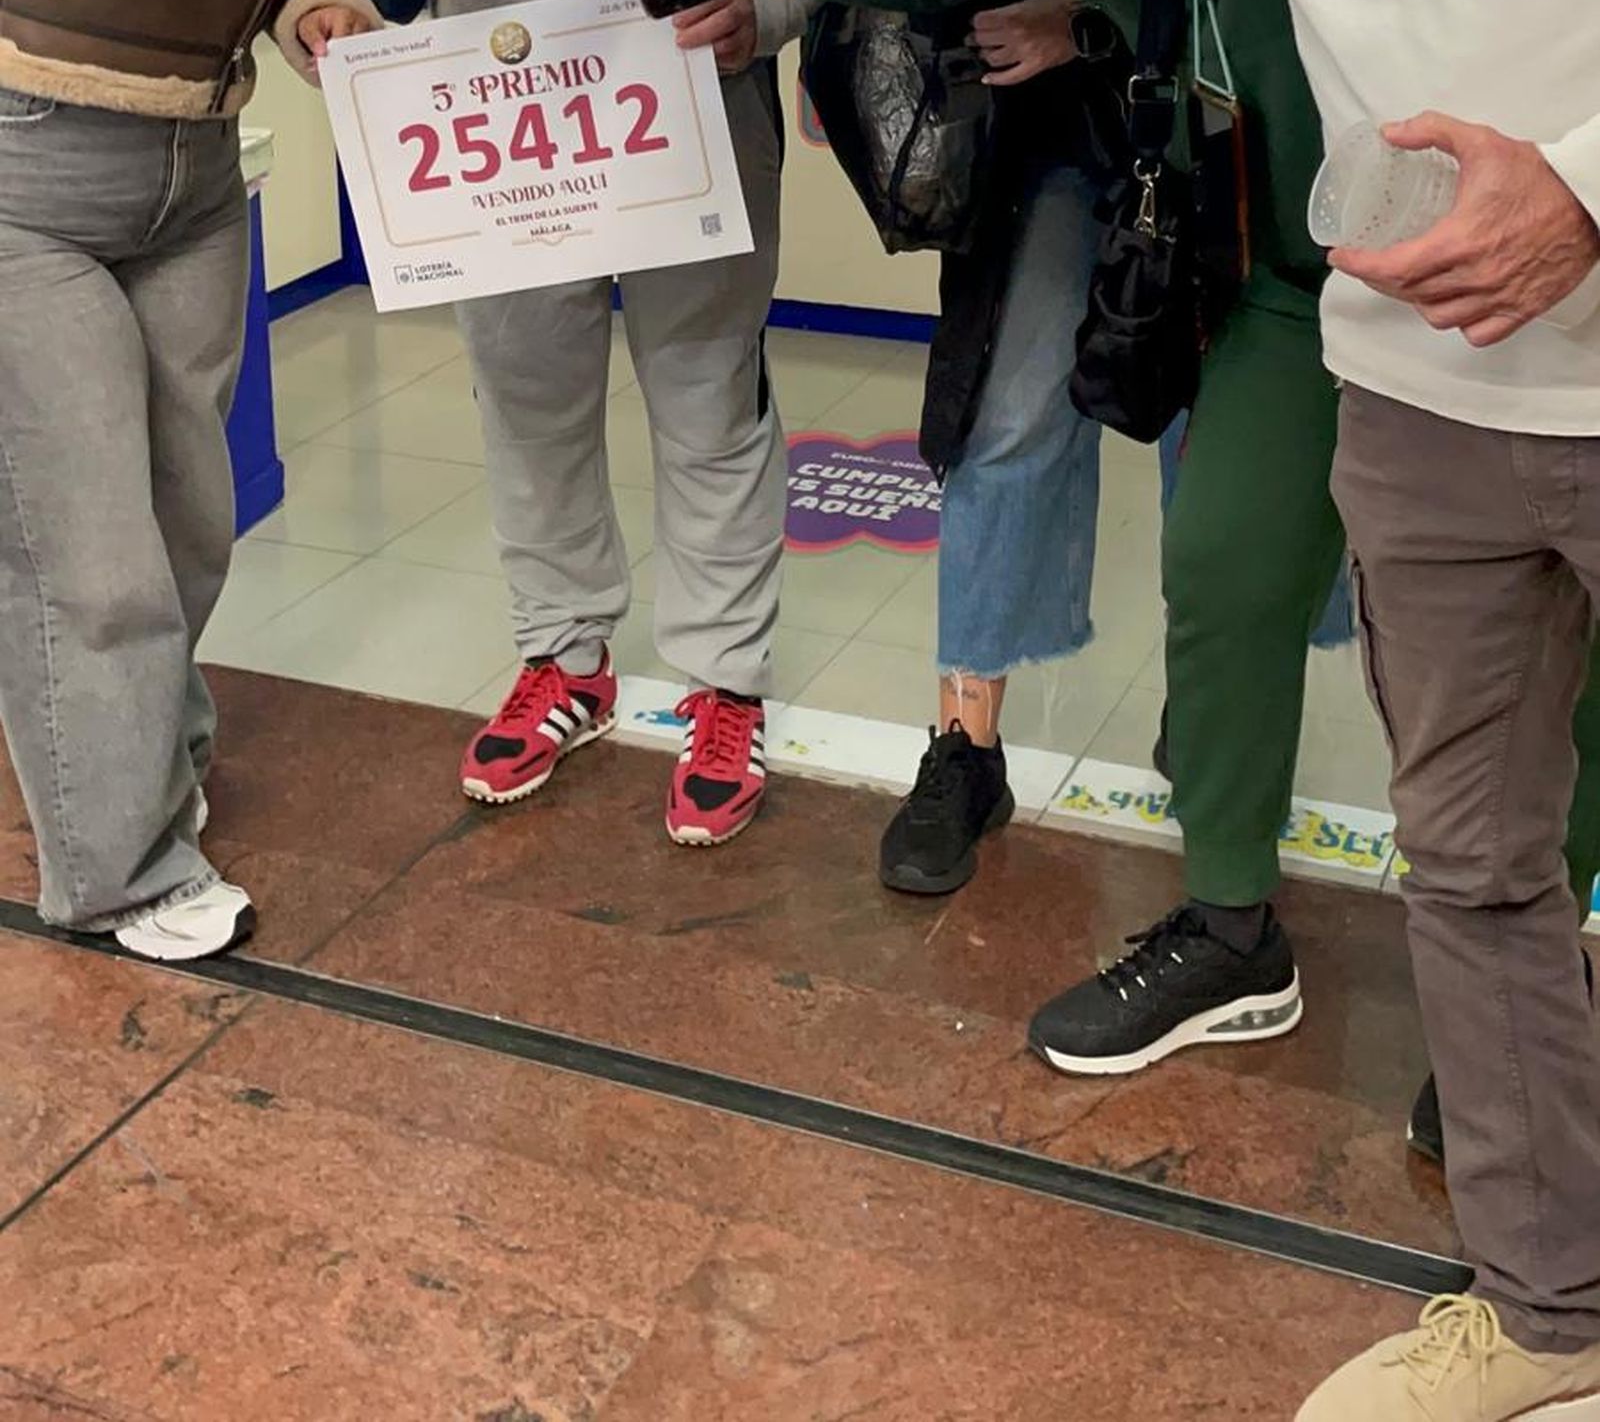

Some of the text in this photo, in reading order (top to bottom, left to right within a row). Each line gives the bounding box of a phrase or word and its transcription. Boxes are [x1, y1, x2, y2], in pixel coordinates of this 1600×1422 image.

[469, 55, 606, 104] PREMIO
[399, 83, 670, 193] 25412
[472, 183, 555, 209] VENDIDO
[495, 201, 599, 227] EL TREN DE LA SUERTE
[417, 268, 464, 282] NACIONAL
